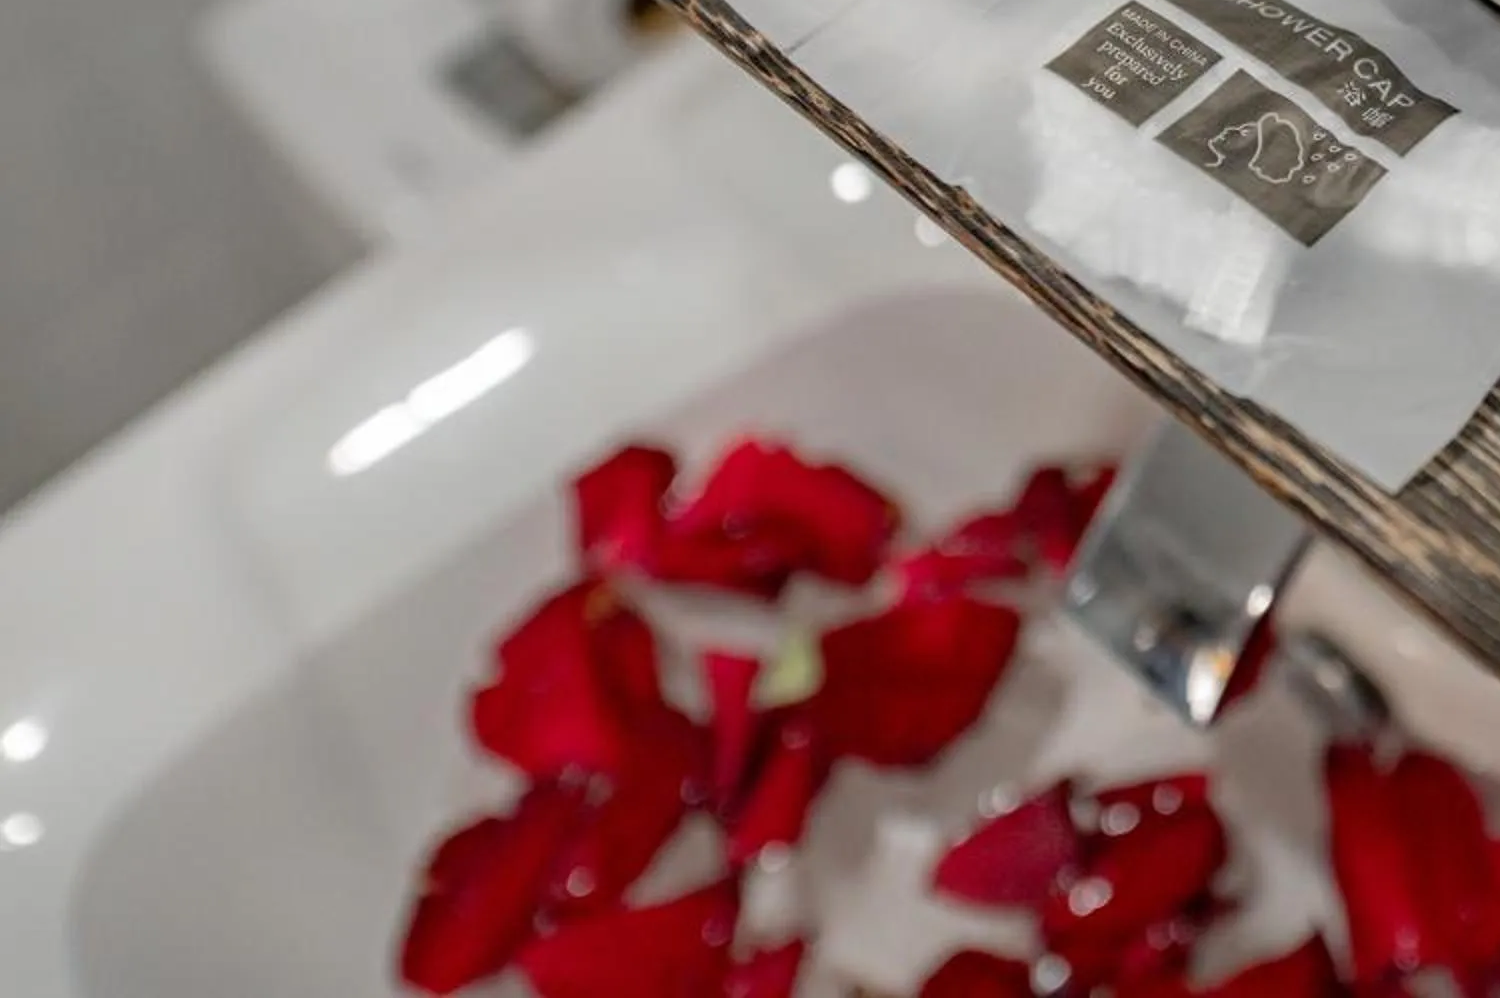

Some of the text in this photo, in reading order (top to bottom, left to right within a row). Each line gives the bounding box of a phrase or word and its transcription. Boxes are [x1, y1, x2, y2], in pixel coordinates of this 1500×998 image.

[1105, 22, 1189, 81] Exclusively
[1121, 8, 1159, 34] MADE
[1169, 38, 1208, 66] CHINA
[1096, 40, 1167, 85] prepared
[1103, 64, 1129, 85] for
[1353, 57, 1415, 107] CAP
[1080, 76, 1117, 100] you
